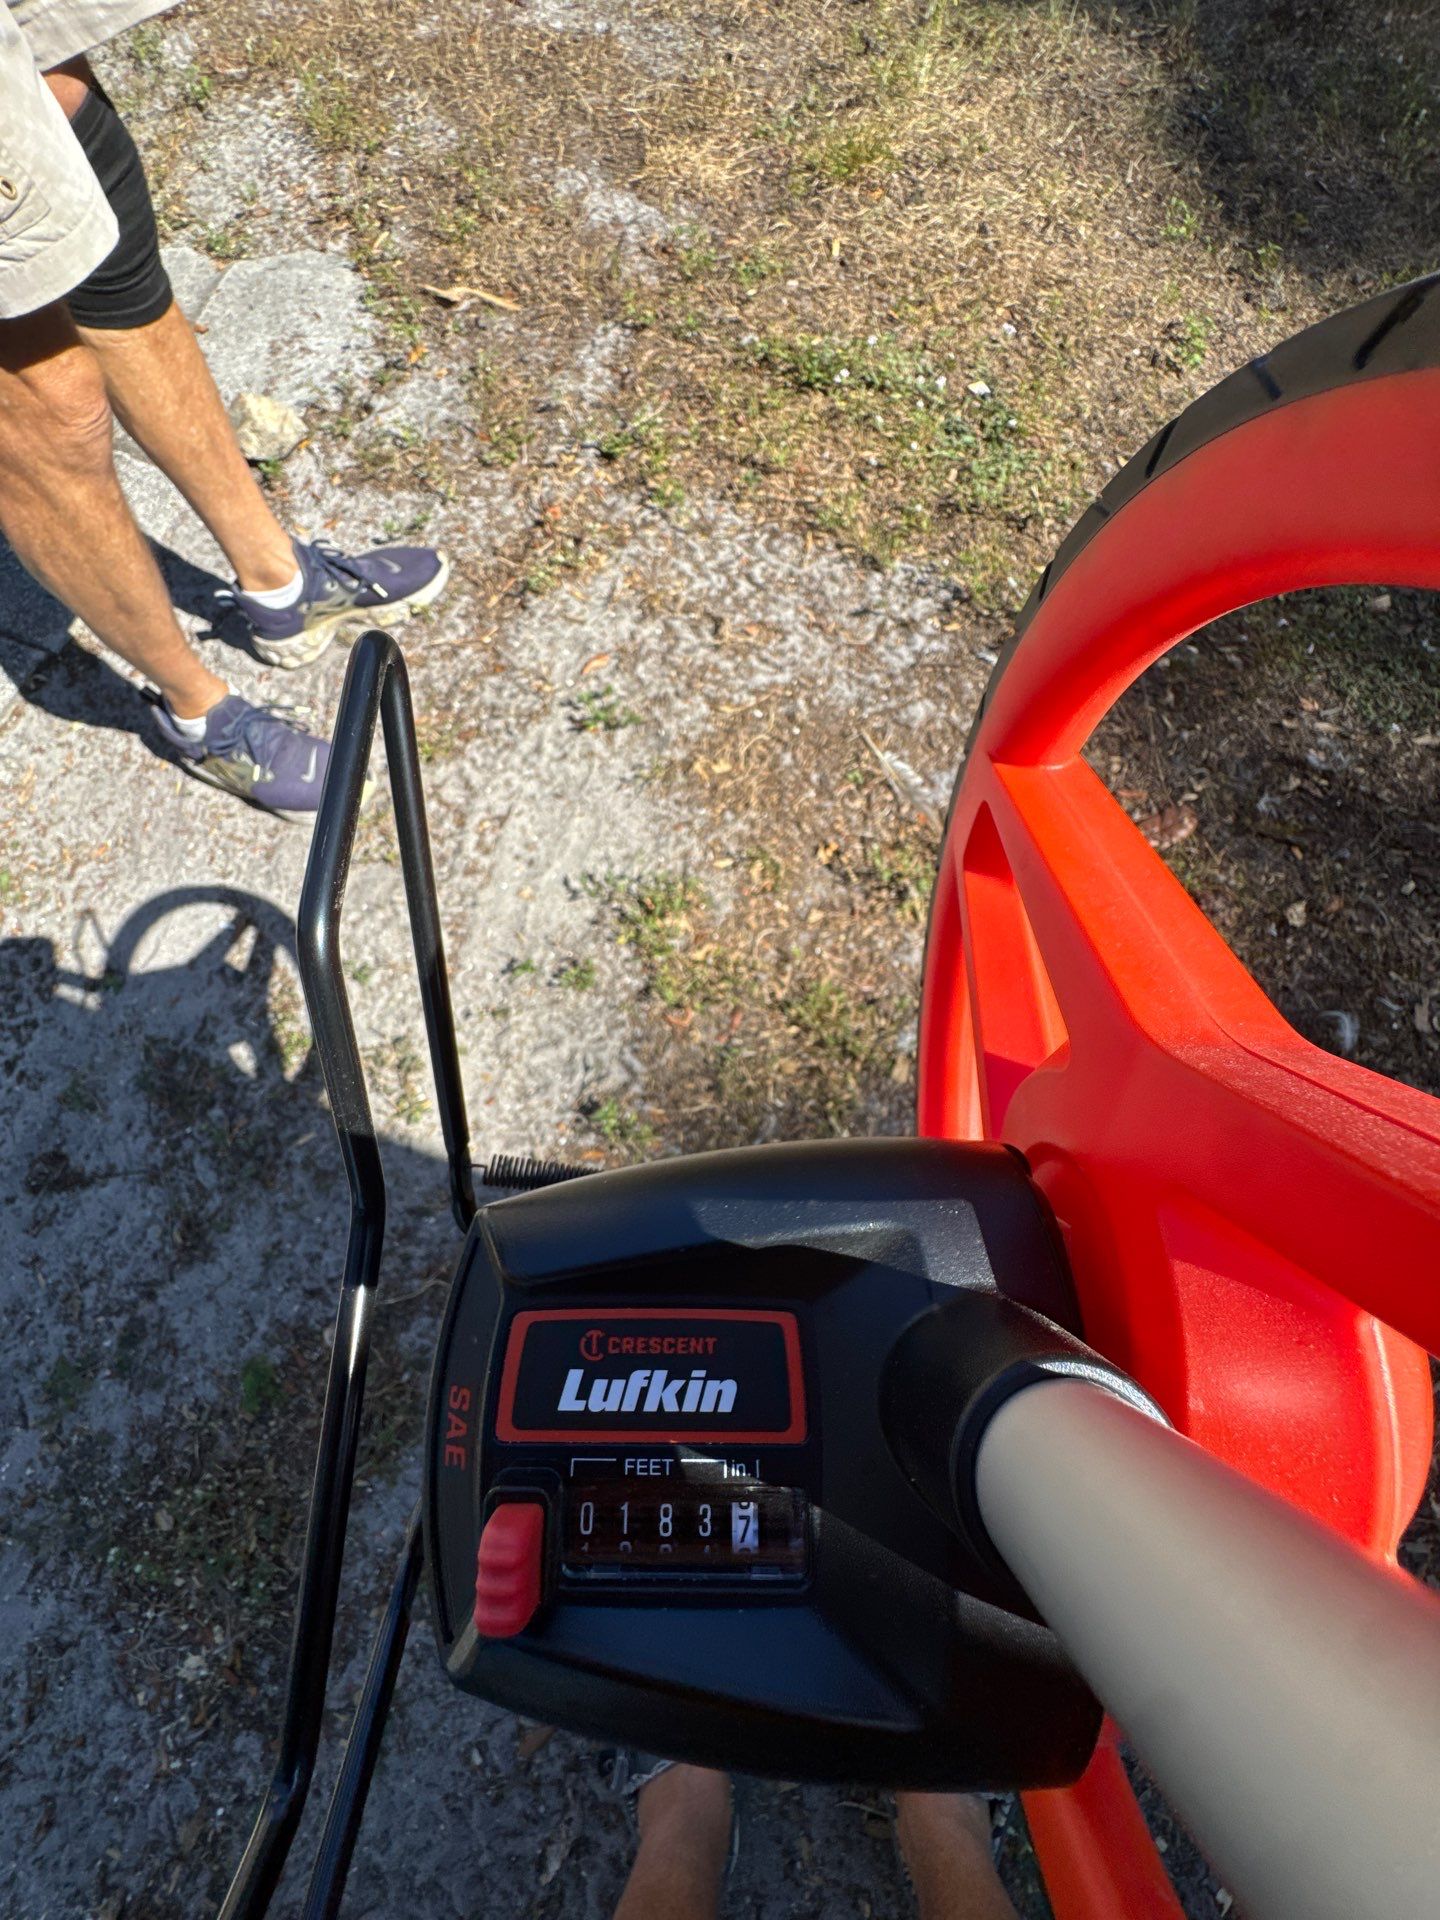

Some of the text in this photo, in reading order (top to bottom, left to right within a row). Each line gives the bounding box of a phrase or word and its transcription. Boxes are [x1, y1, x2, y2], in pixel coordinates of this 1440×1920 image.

[607, 1336, 717, 1355] CRESCENT
[557, 1368, 738, 1413] Lufkin
[444, 1385, 472, 1470] SAE
[624, 1459, 674, 1476] FEET
